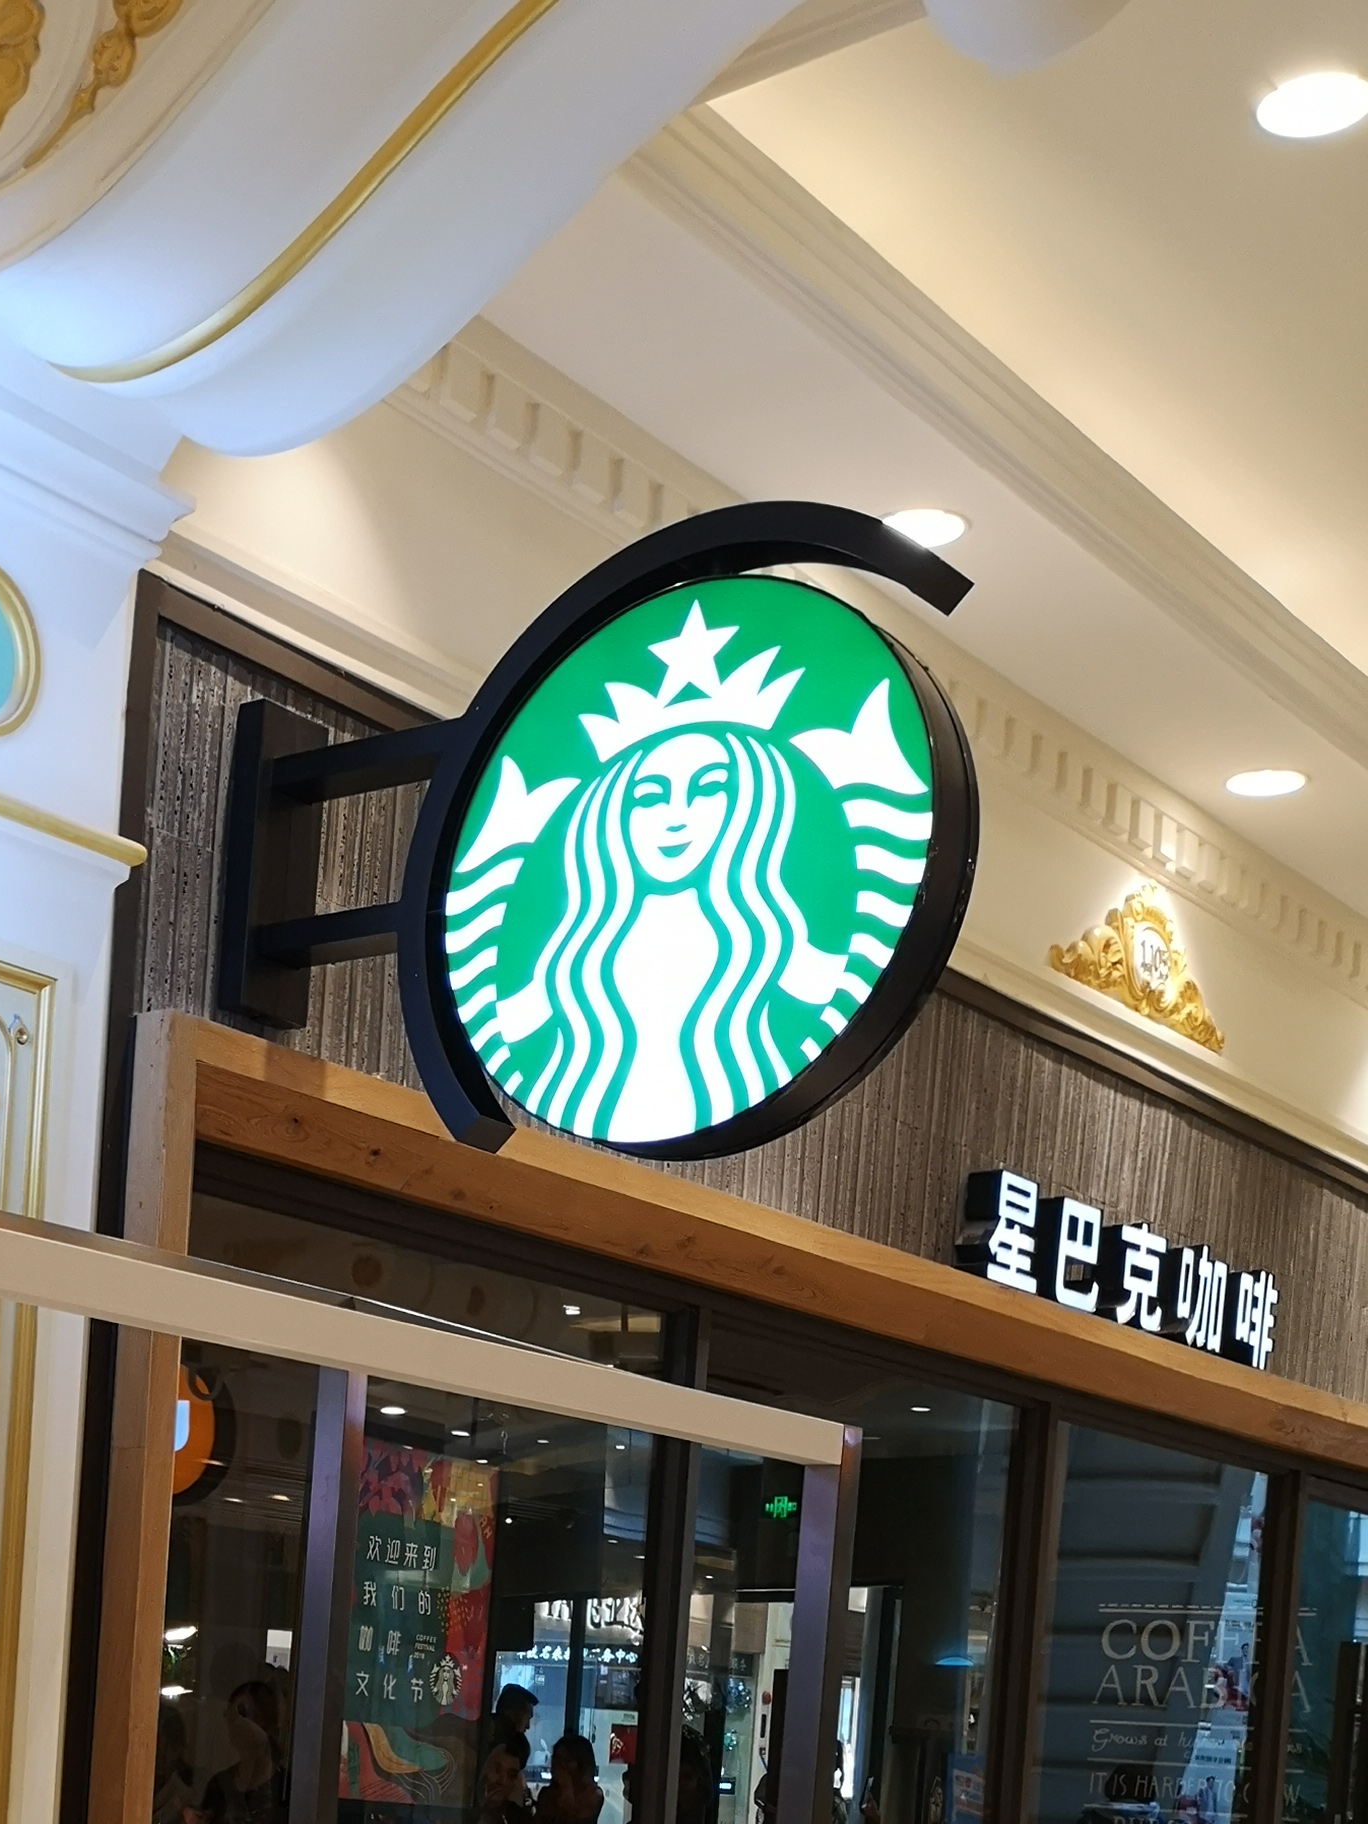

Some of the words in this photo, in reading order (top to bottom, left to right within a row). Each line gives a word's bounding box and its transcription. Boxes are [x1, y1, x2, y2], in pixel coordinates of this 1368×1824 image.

[986, 1169, 1279, 1371] 星巴克咖啡
[366, 1535, 437, 1571] 欢迎来到
[363, 1581, 432, 1615] 我们的
[358, 1625, 402, 1655] 咖啡
[355, 1671, 424, 1702] 文化节
[1091, 1728, 1148, 1751] Grows
[1089, 1772, 1107, 1795] IT
[1112, 1774, 1127, 1796] IS
